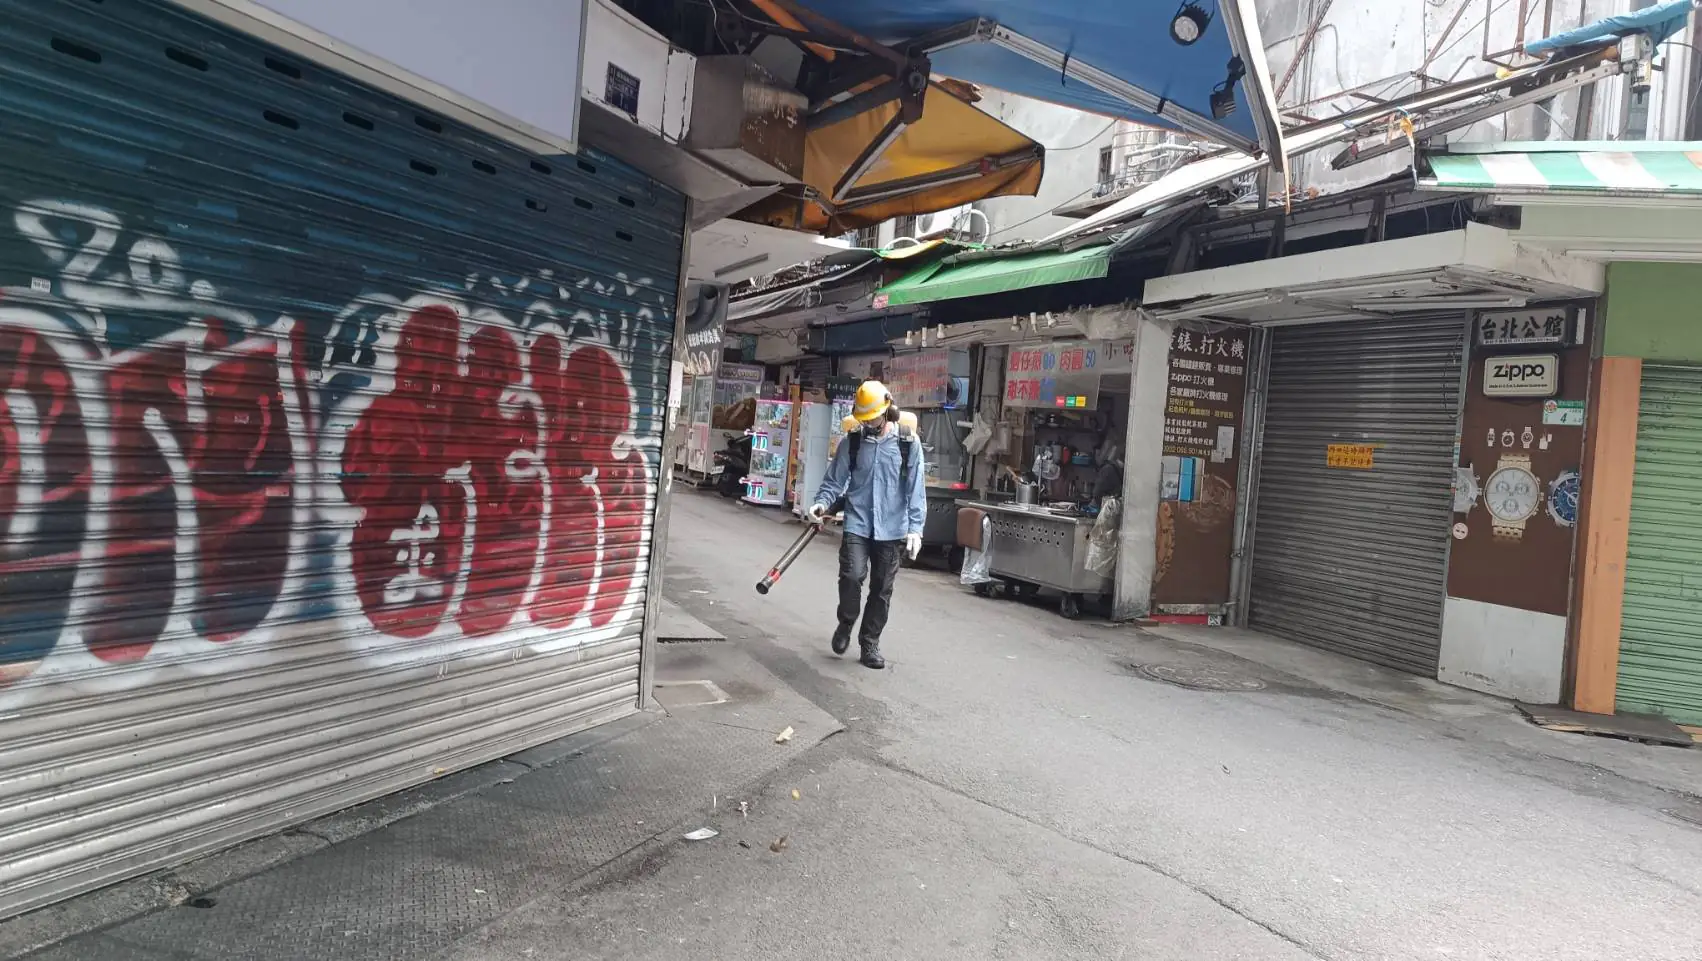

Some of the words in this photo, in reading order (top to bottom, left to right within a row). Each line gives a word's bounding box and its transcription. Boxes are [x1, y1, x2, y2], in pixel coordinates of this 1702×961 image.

[1481, 315, 1564, 340] 台北公館
[1560, 412, 1568, 424] 4
